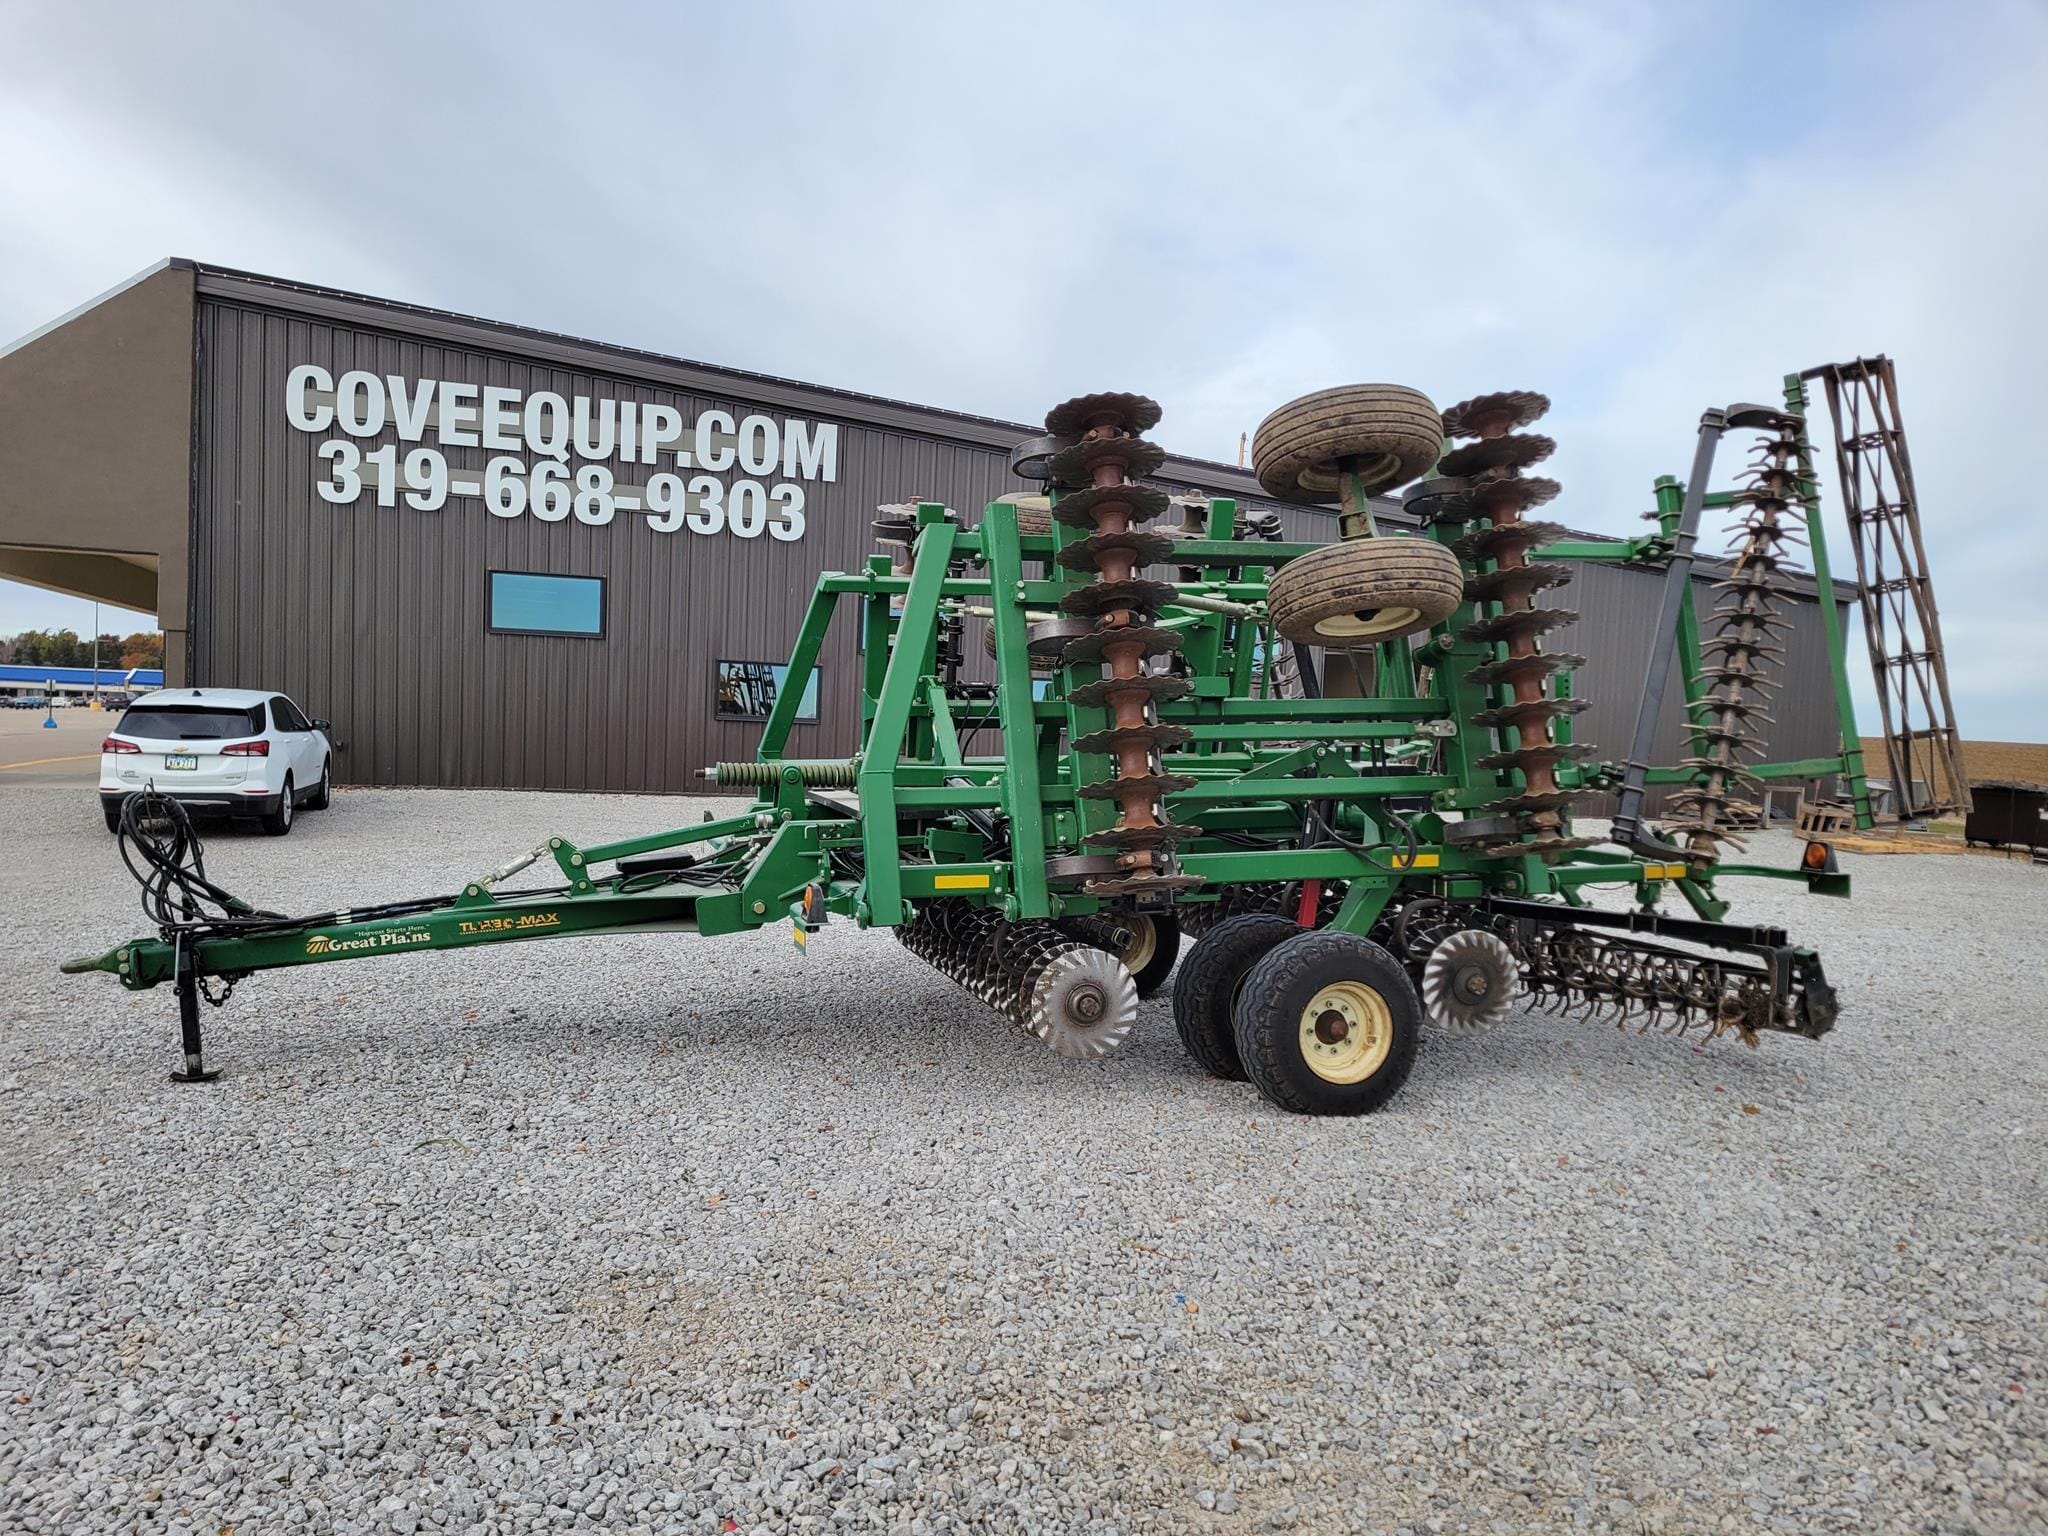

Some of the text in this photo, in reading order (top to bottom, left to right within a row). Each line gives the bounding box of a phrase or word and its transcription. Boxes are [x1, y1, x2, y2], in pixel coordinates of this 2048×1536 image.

[285, 364, 839, 483] COVEEQUIP.COM
[316, 439, 806, 542] 319-668-9303
[328, 936, 377, 952] Great
